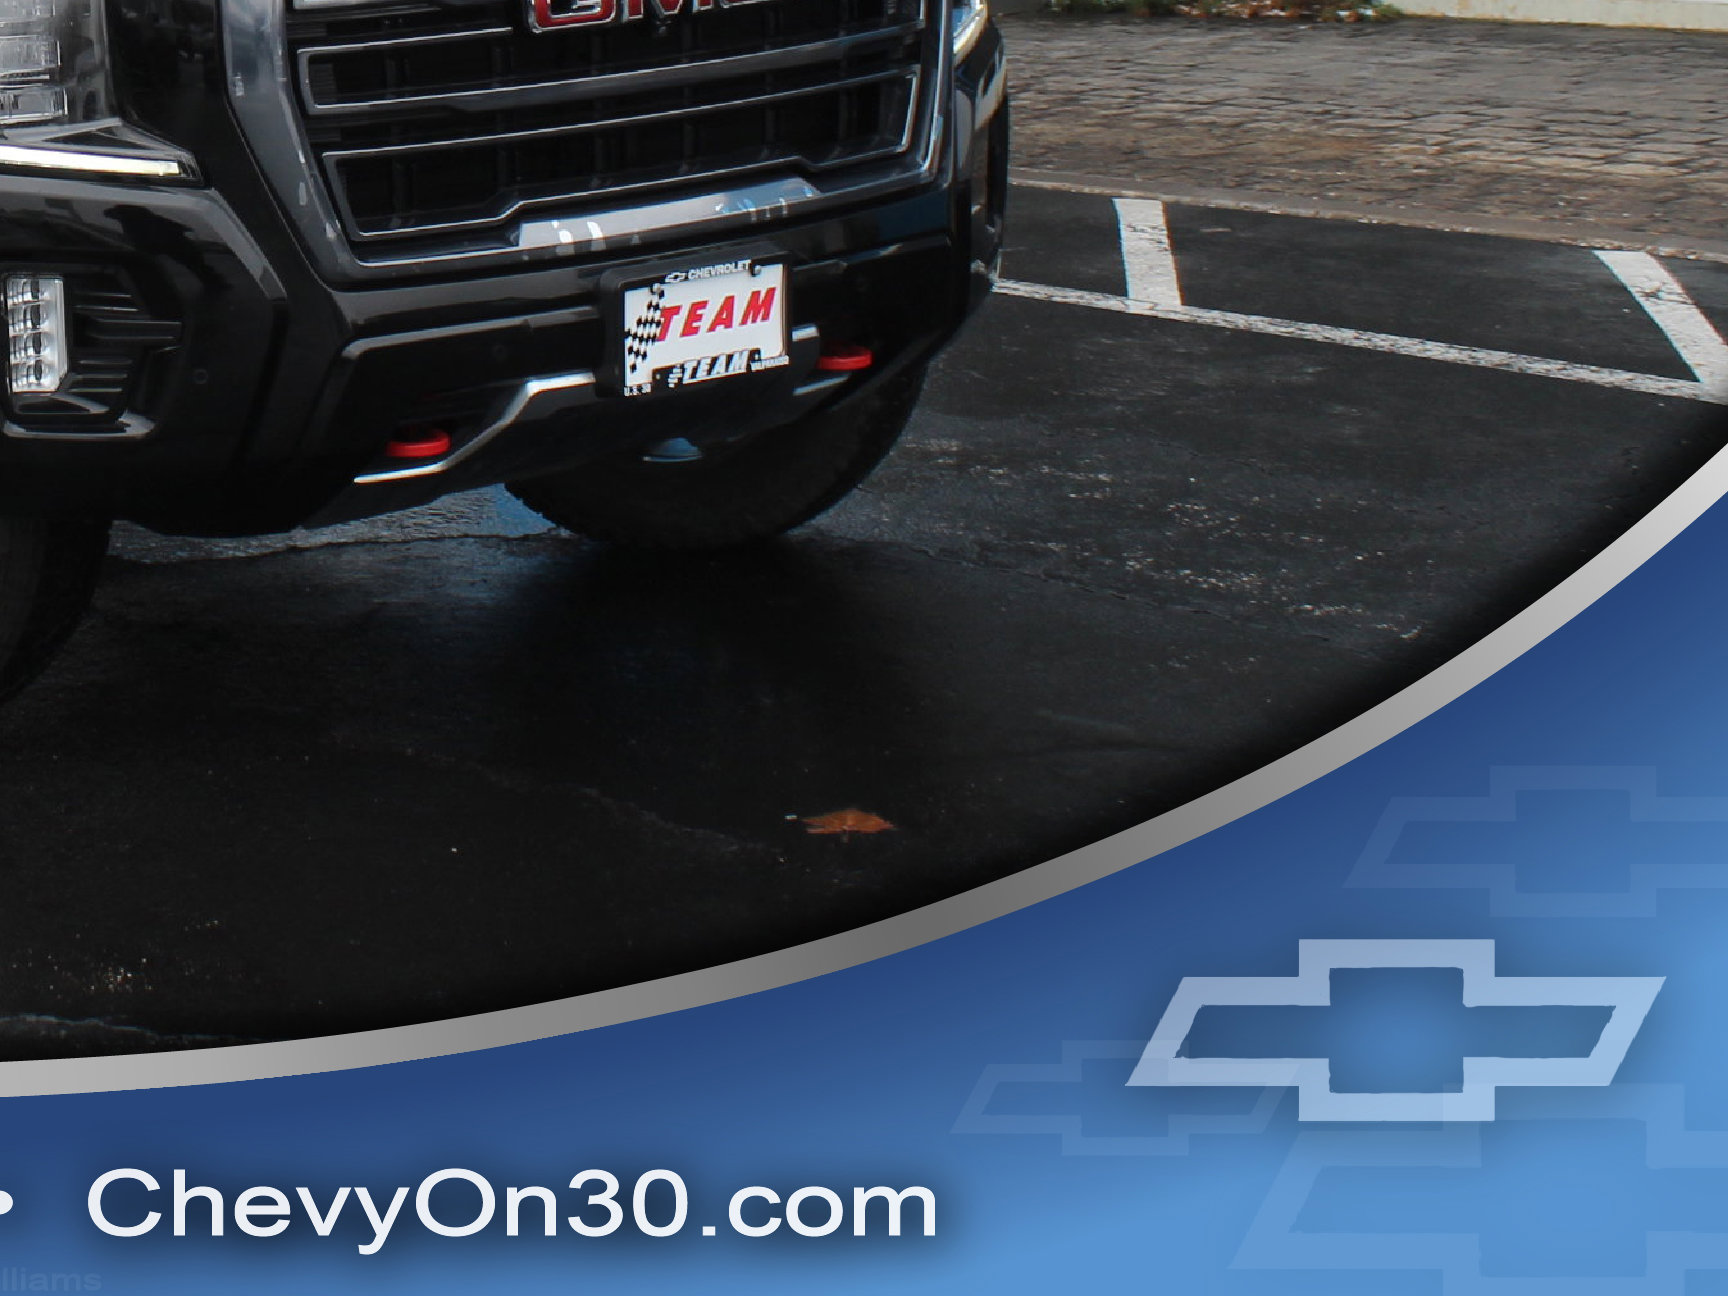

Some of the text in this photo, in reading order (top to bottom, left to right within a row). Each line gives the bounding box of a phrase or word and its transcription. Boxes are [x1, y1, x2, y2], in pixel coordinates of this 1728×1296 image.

[687, 259, 752, 280] CHEVROLET
[655, 287, 776, 342] TEAM
[682, 350, 750, 384] TEAM
